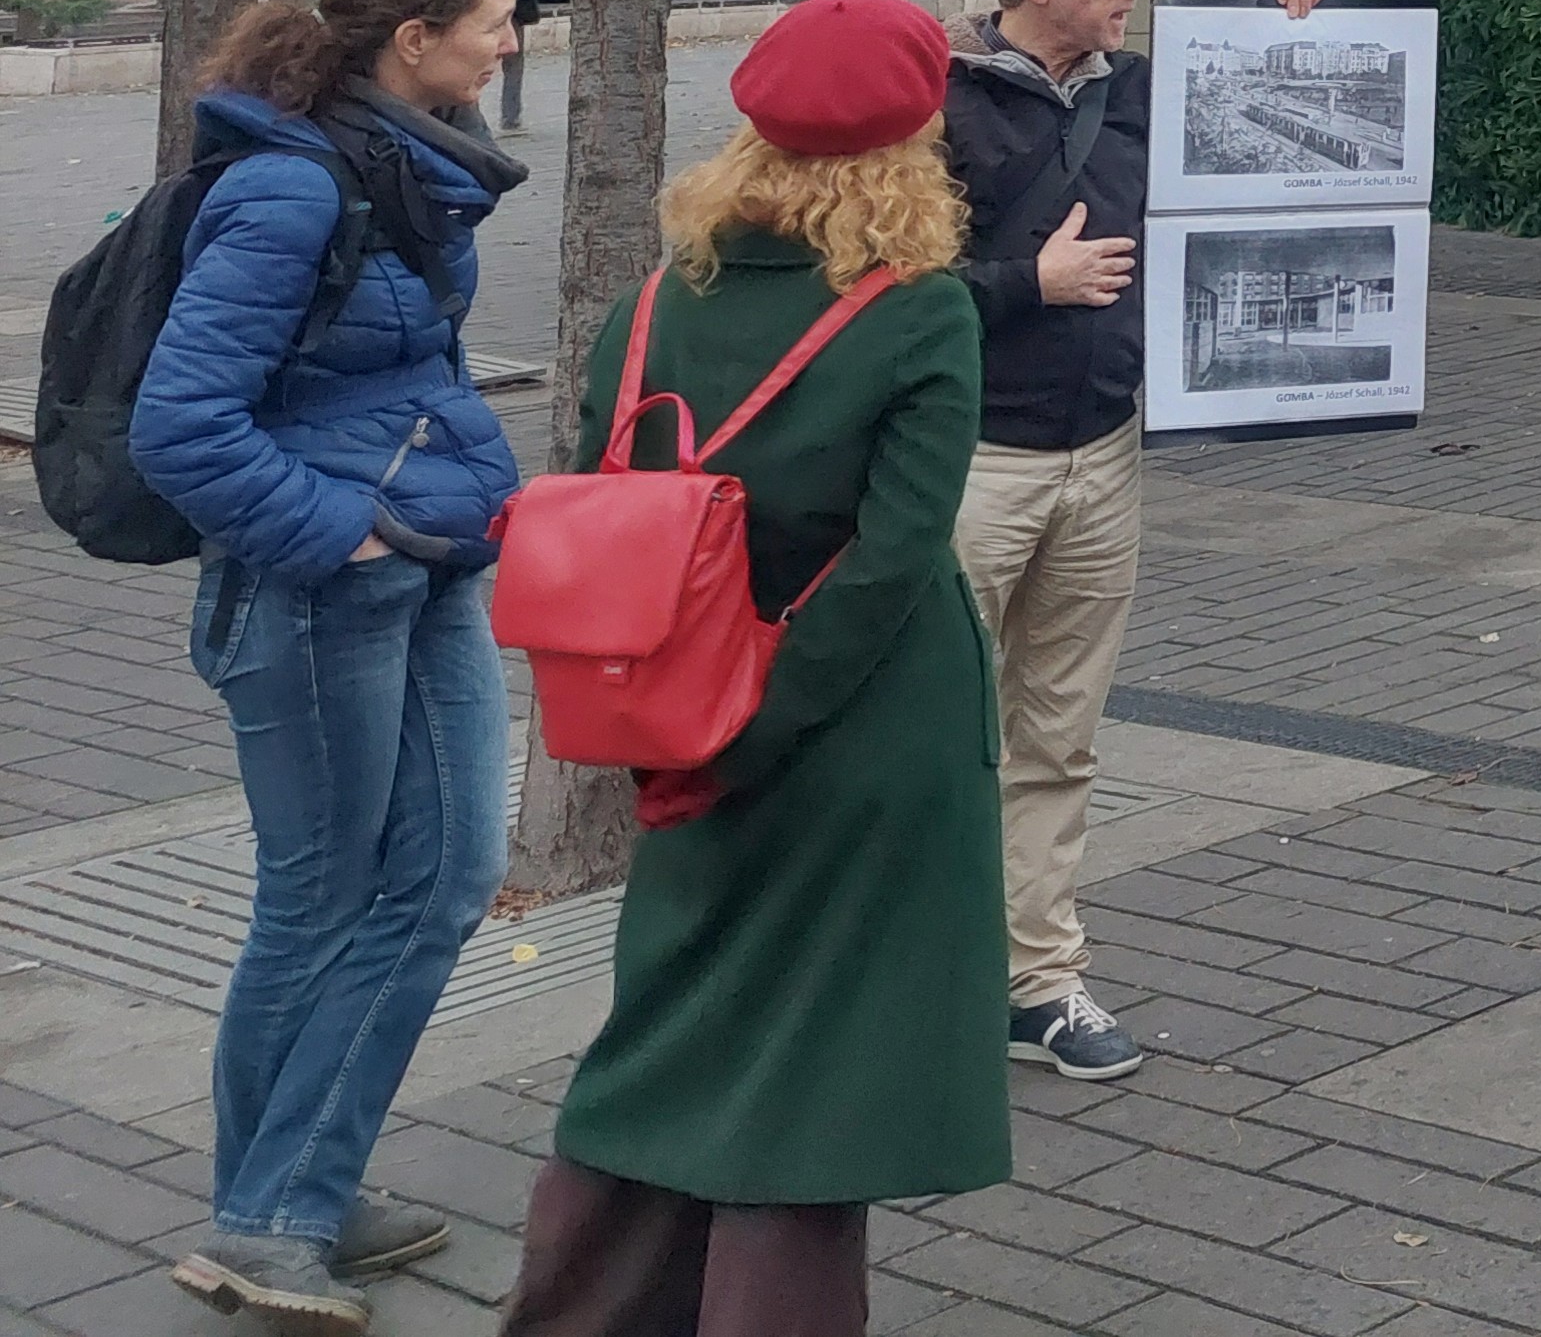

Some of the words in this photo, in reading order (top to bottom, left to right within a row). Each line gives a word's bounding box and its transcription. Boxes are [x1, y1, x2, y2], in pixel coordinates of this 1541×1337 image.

[1283, 178, 1323, 188] GOMBA
[1333, 177, 1361, 188] József
[1363, 176, 1392, 187] Schall,
[1396, 176, 1418, 185] 1942
[1276, 391, 1315, 403] GOMBA
[1325, 388, 1353, 400] József
[1388, 385, 1411, 395] 1942
